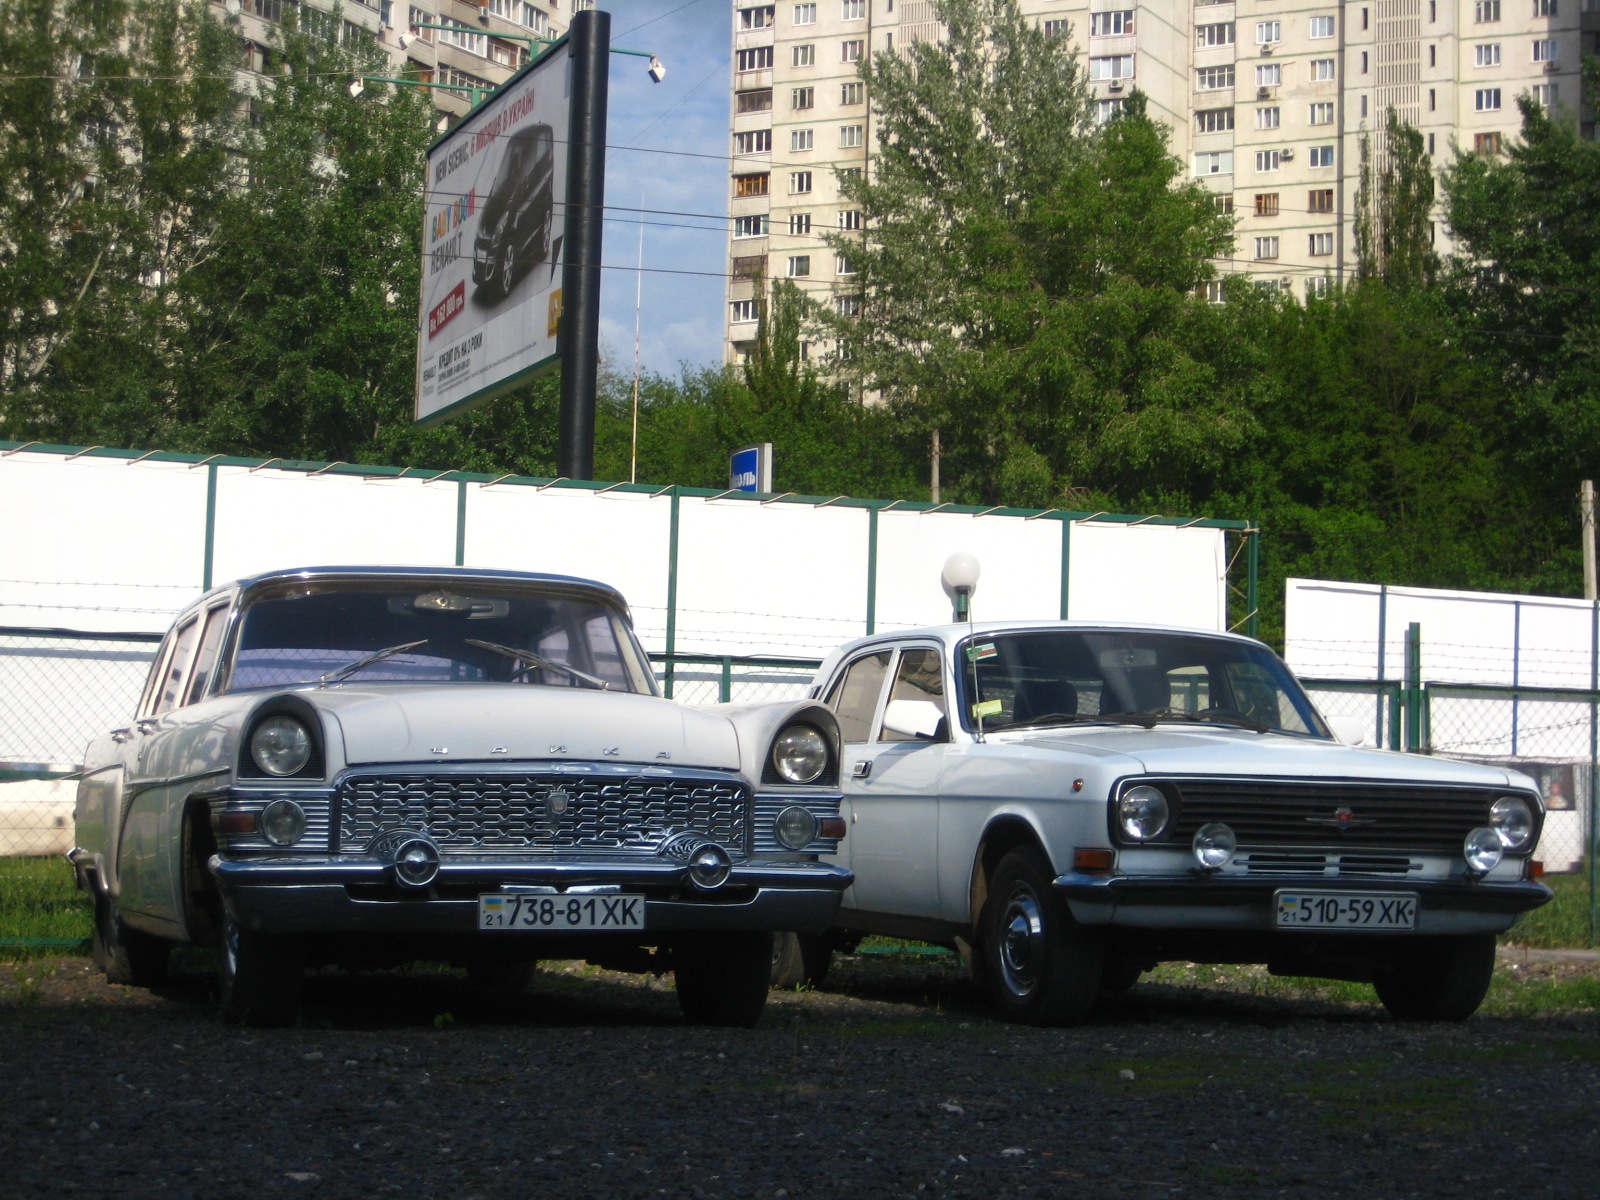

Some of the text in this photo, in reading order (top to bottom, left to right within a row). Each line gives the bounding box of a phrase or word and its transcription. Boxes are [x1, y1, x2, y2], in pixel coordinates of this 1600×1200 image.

[432, 204, 452, 243] BABY
[430, 231, 463, 276] RENAULT
[485, 898, 639, 926] 21 738-81XK
[1282, 911, 1297, 922] 21
